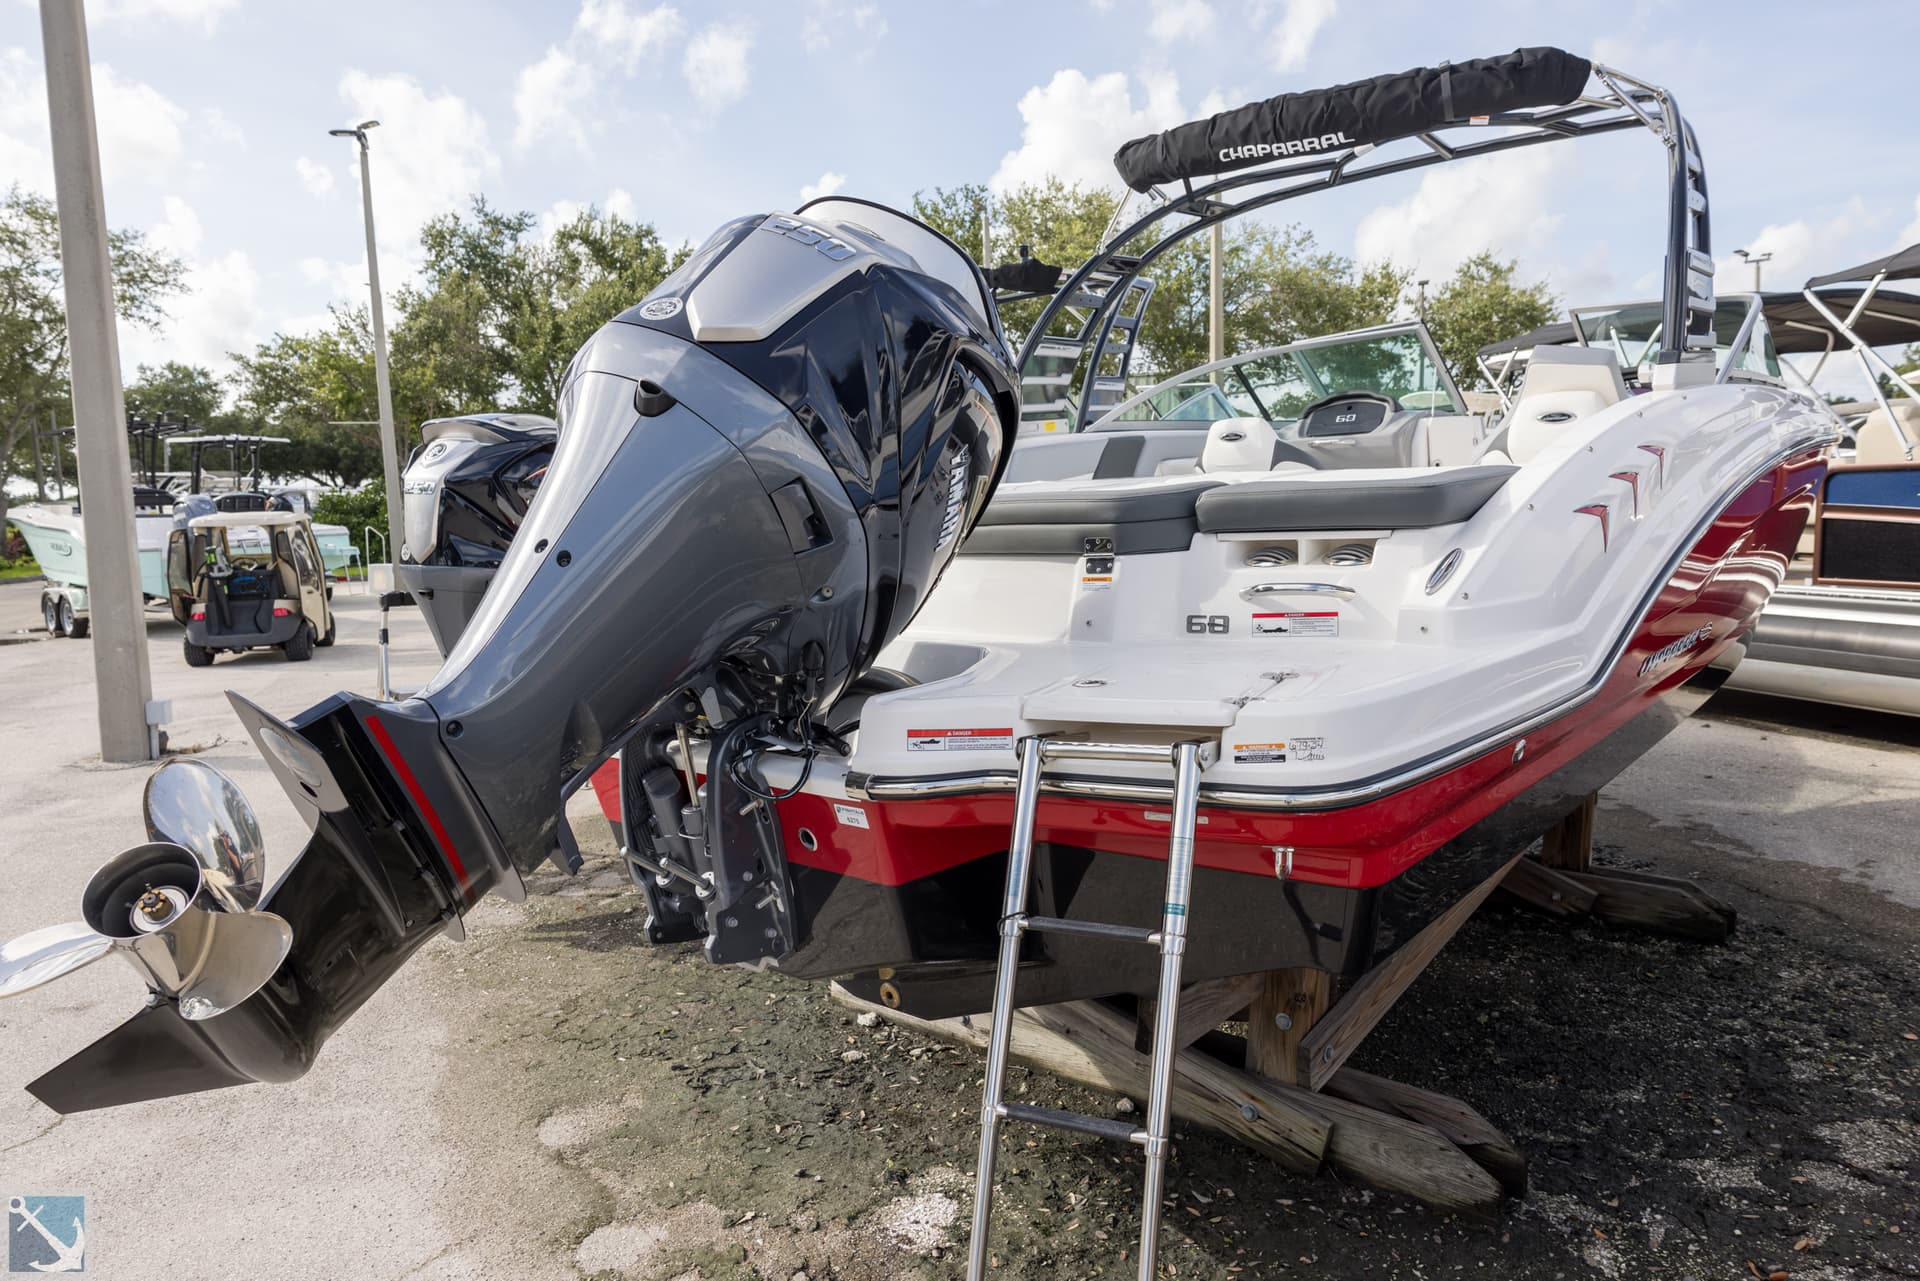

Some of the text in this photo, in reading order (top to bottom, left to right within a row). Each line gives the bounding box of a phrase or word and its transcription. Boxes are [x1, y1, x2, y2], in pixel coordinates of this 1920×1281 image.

[1219, 131, 1356, 162] CHAPARRAL
[760, 216, 857, 262] 250
[934, 444, 969, 552] YAMAHA
